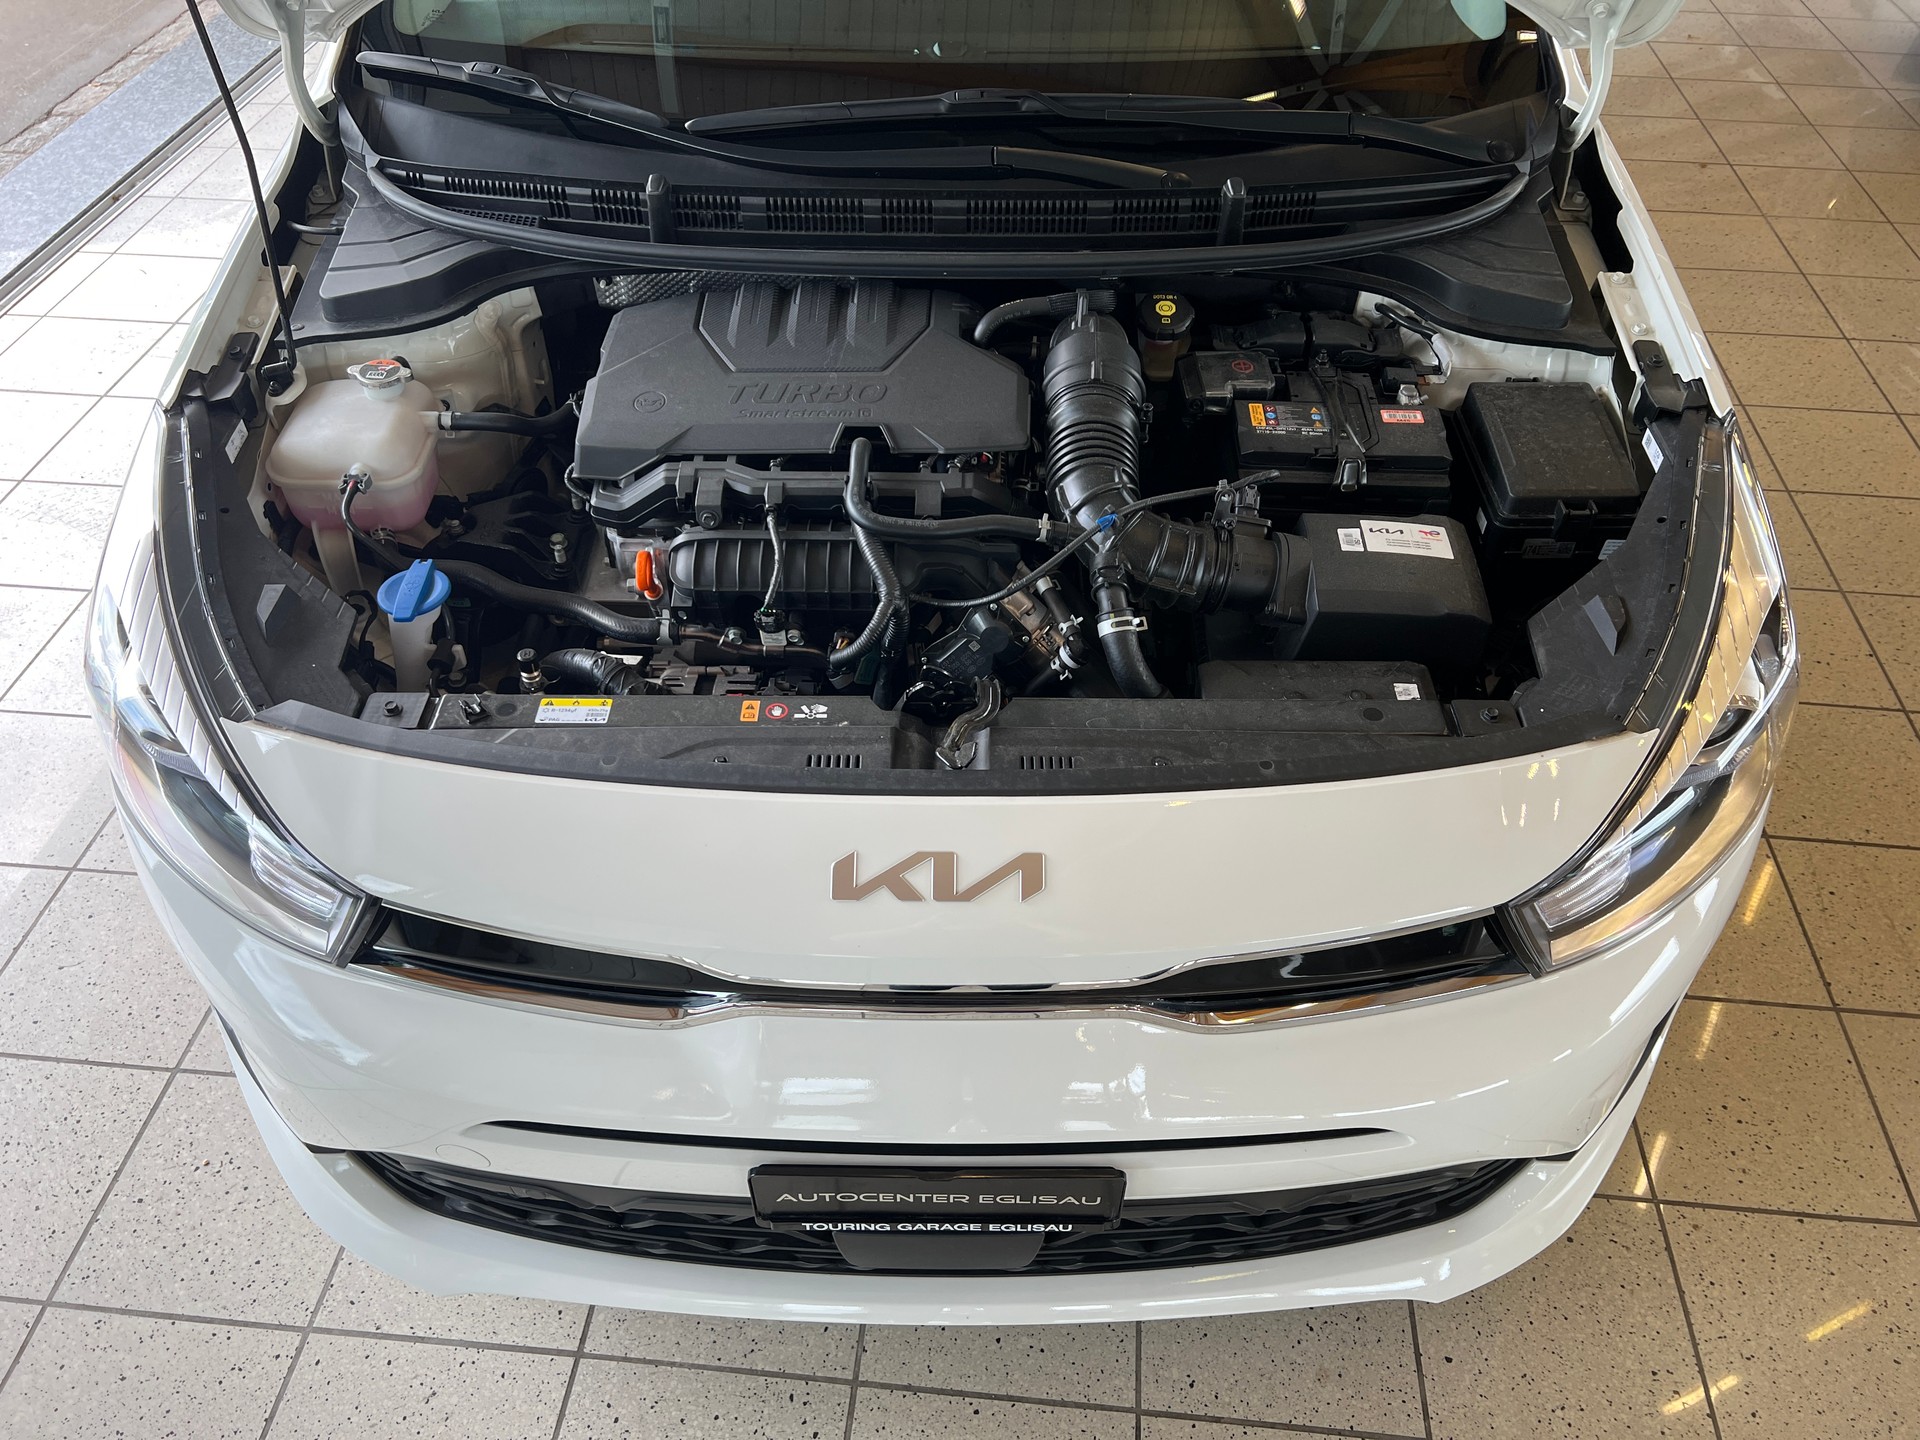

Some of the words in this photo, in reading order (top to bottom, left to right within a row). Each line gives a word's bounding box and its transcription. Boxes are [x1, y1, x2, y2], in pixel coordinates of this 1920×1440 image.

[727, 382, 888, 405] TURBO
[737, 408, 855, 419] Smartstream
[1369, 527, 1404, 535] KIA
[830, 850, 1045, 902] KIA
[776, 1192, 970, 1204] AUTOCENTER
[978, 1194, 1102, 1206] EGLISAU
[801, 1222, 892, 1232] TOURING
[897, 1222, 982, 1232] GARAGE
[988, 1223, 1073, 1233] EGLISAU
